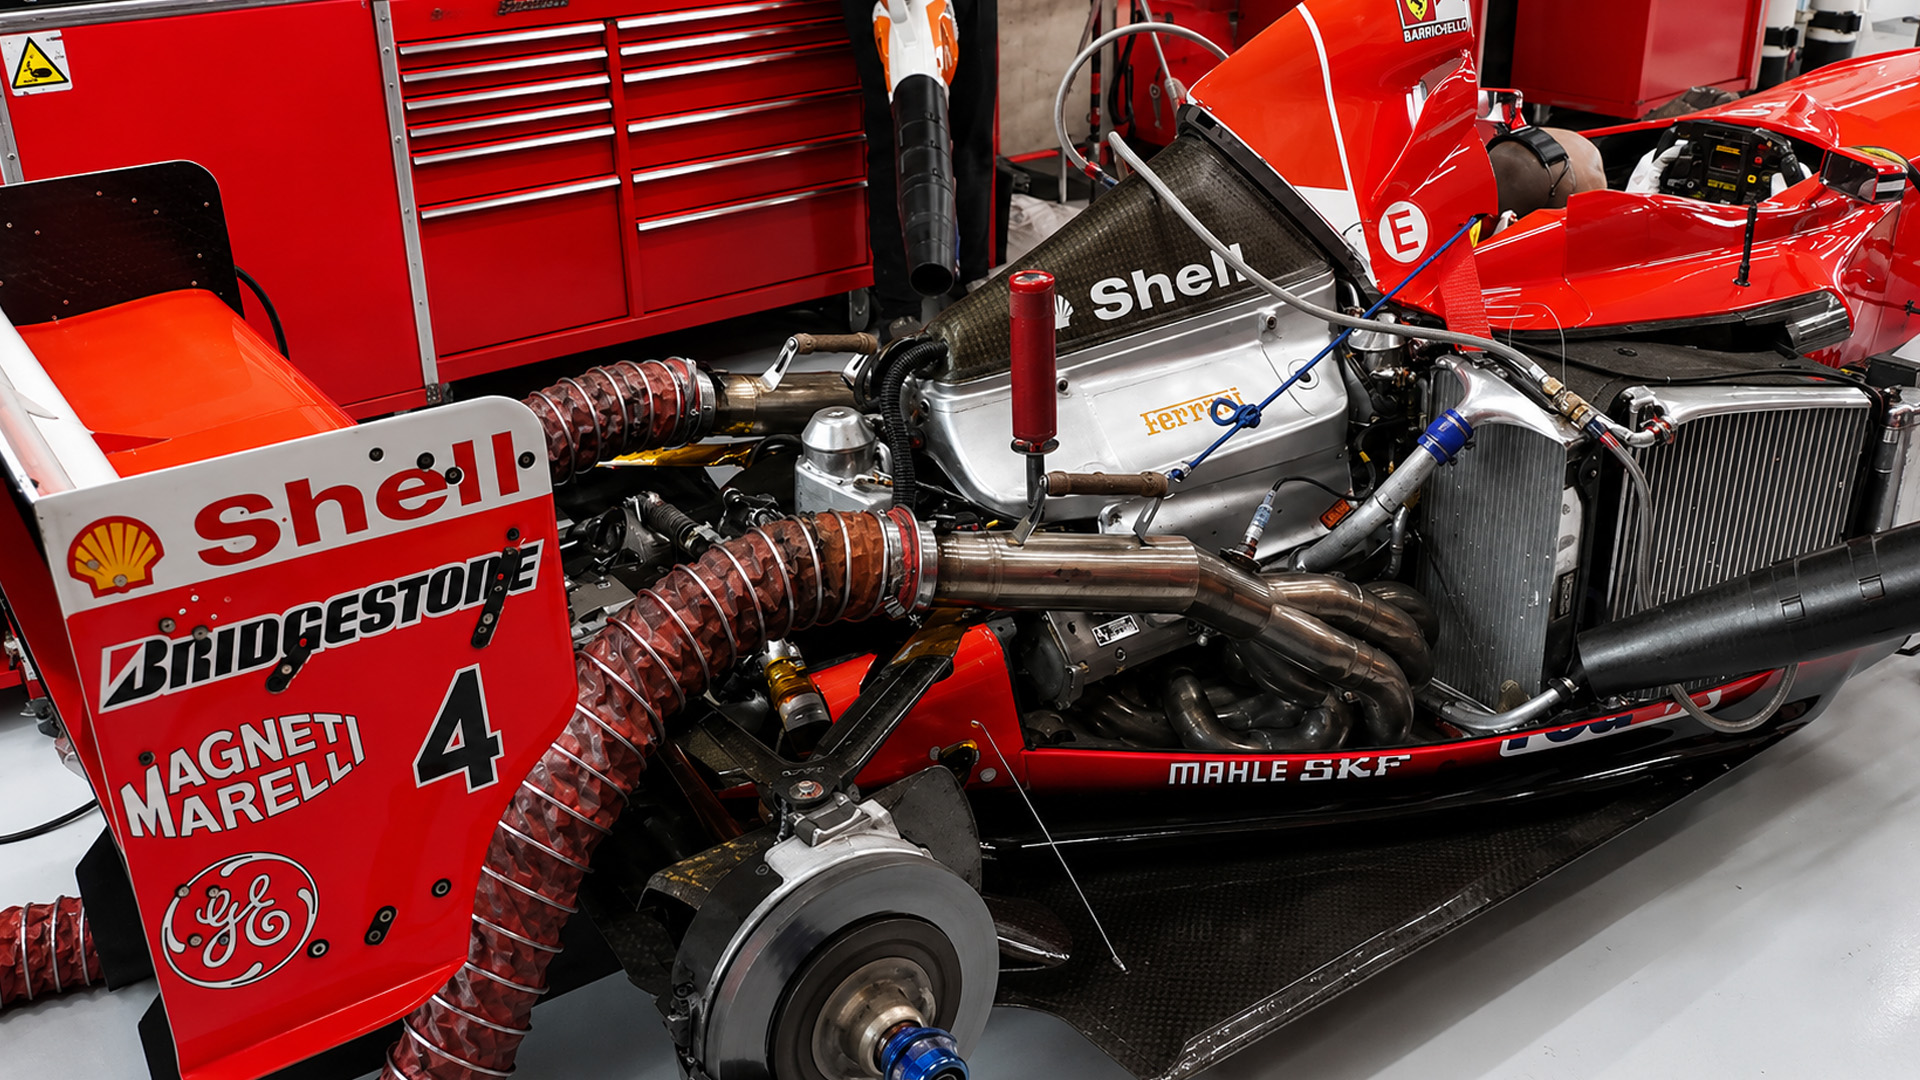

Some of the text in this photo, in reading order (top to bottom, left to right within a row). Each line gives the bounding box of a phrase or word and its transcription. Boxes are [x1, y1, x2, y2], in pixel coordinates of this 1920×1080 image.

[1090, 243, 1248, 320] Shell
[1387, 209, 1419, 254] E
[194, 431, 520, 566] Shell
[102, 543, 542, 708] BRIDGESTONE
[120, 713, 366, 838] MAGNETI
[414, 664, 503, 793] 4
[1168, 754, 1411, 785] MAHLE SKF
